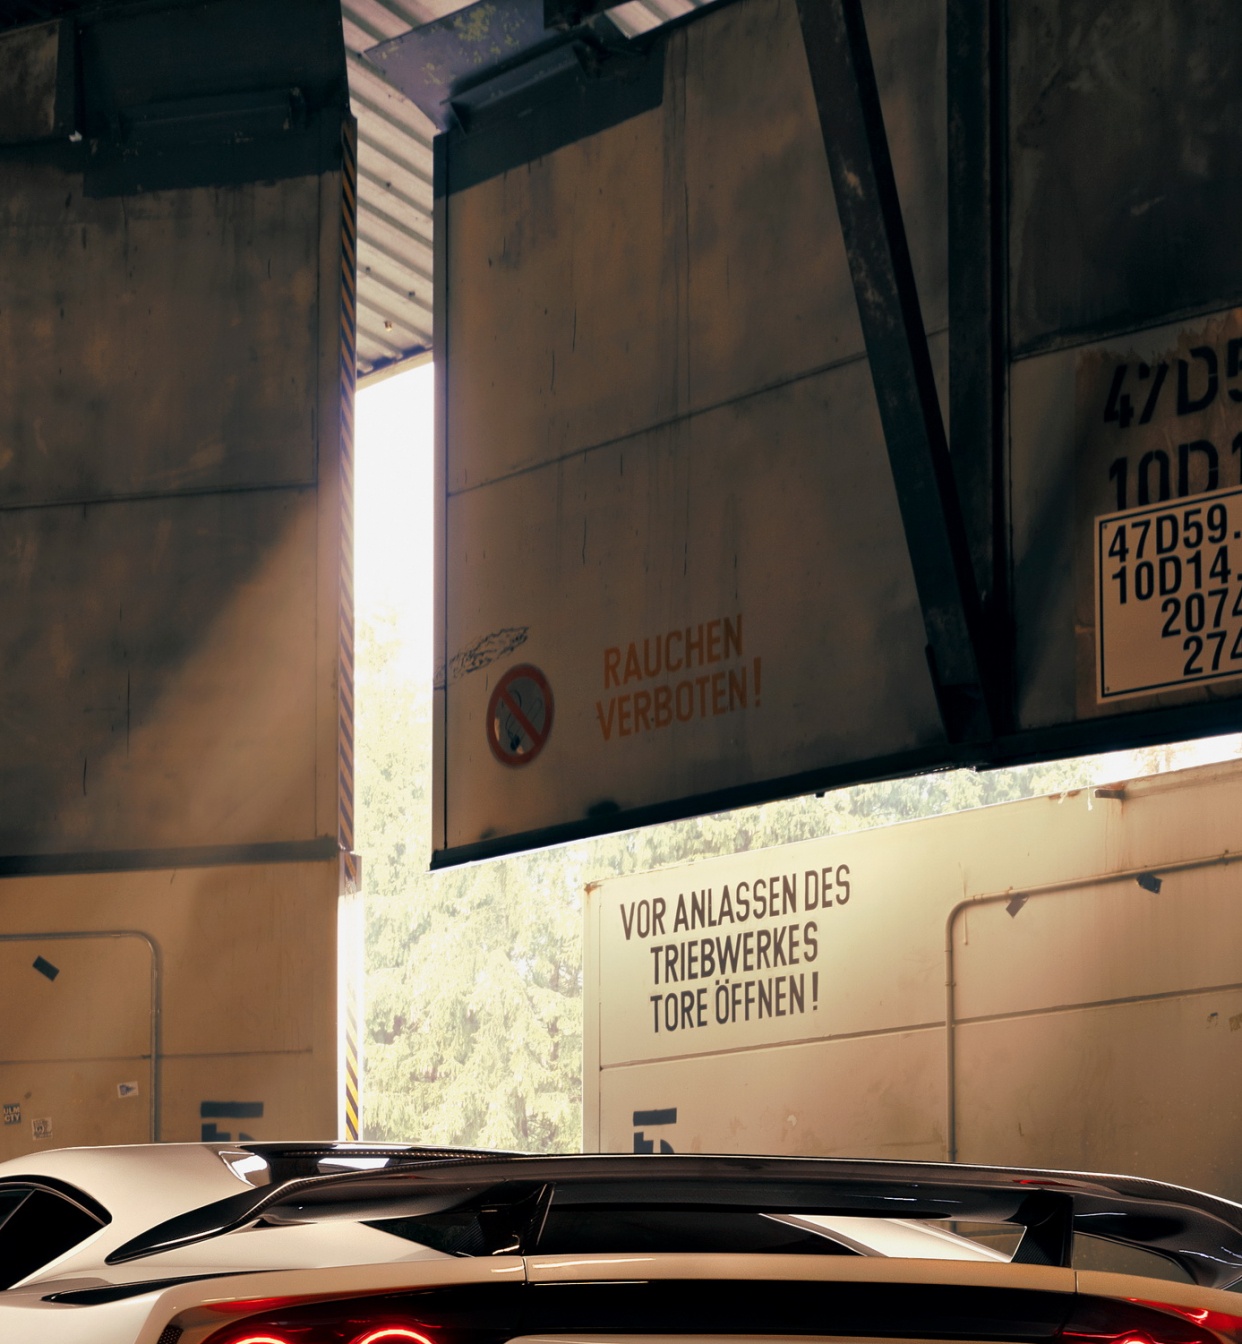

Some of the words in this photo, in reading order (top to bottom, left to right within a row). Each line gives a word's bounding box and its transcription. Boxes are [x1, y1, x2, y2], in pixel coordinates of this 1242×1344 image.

[603, 613, 743, 690] RAUCHEN
[620, 897, 666, 941] VOR
[673, 873, 797, 933] ANLASSEN
[805, 864, 850, 911] DES
[650, 921, 818, 985] TRIEBWERKES
[650, 988, 708, 1033] TORE
